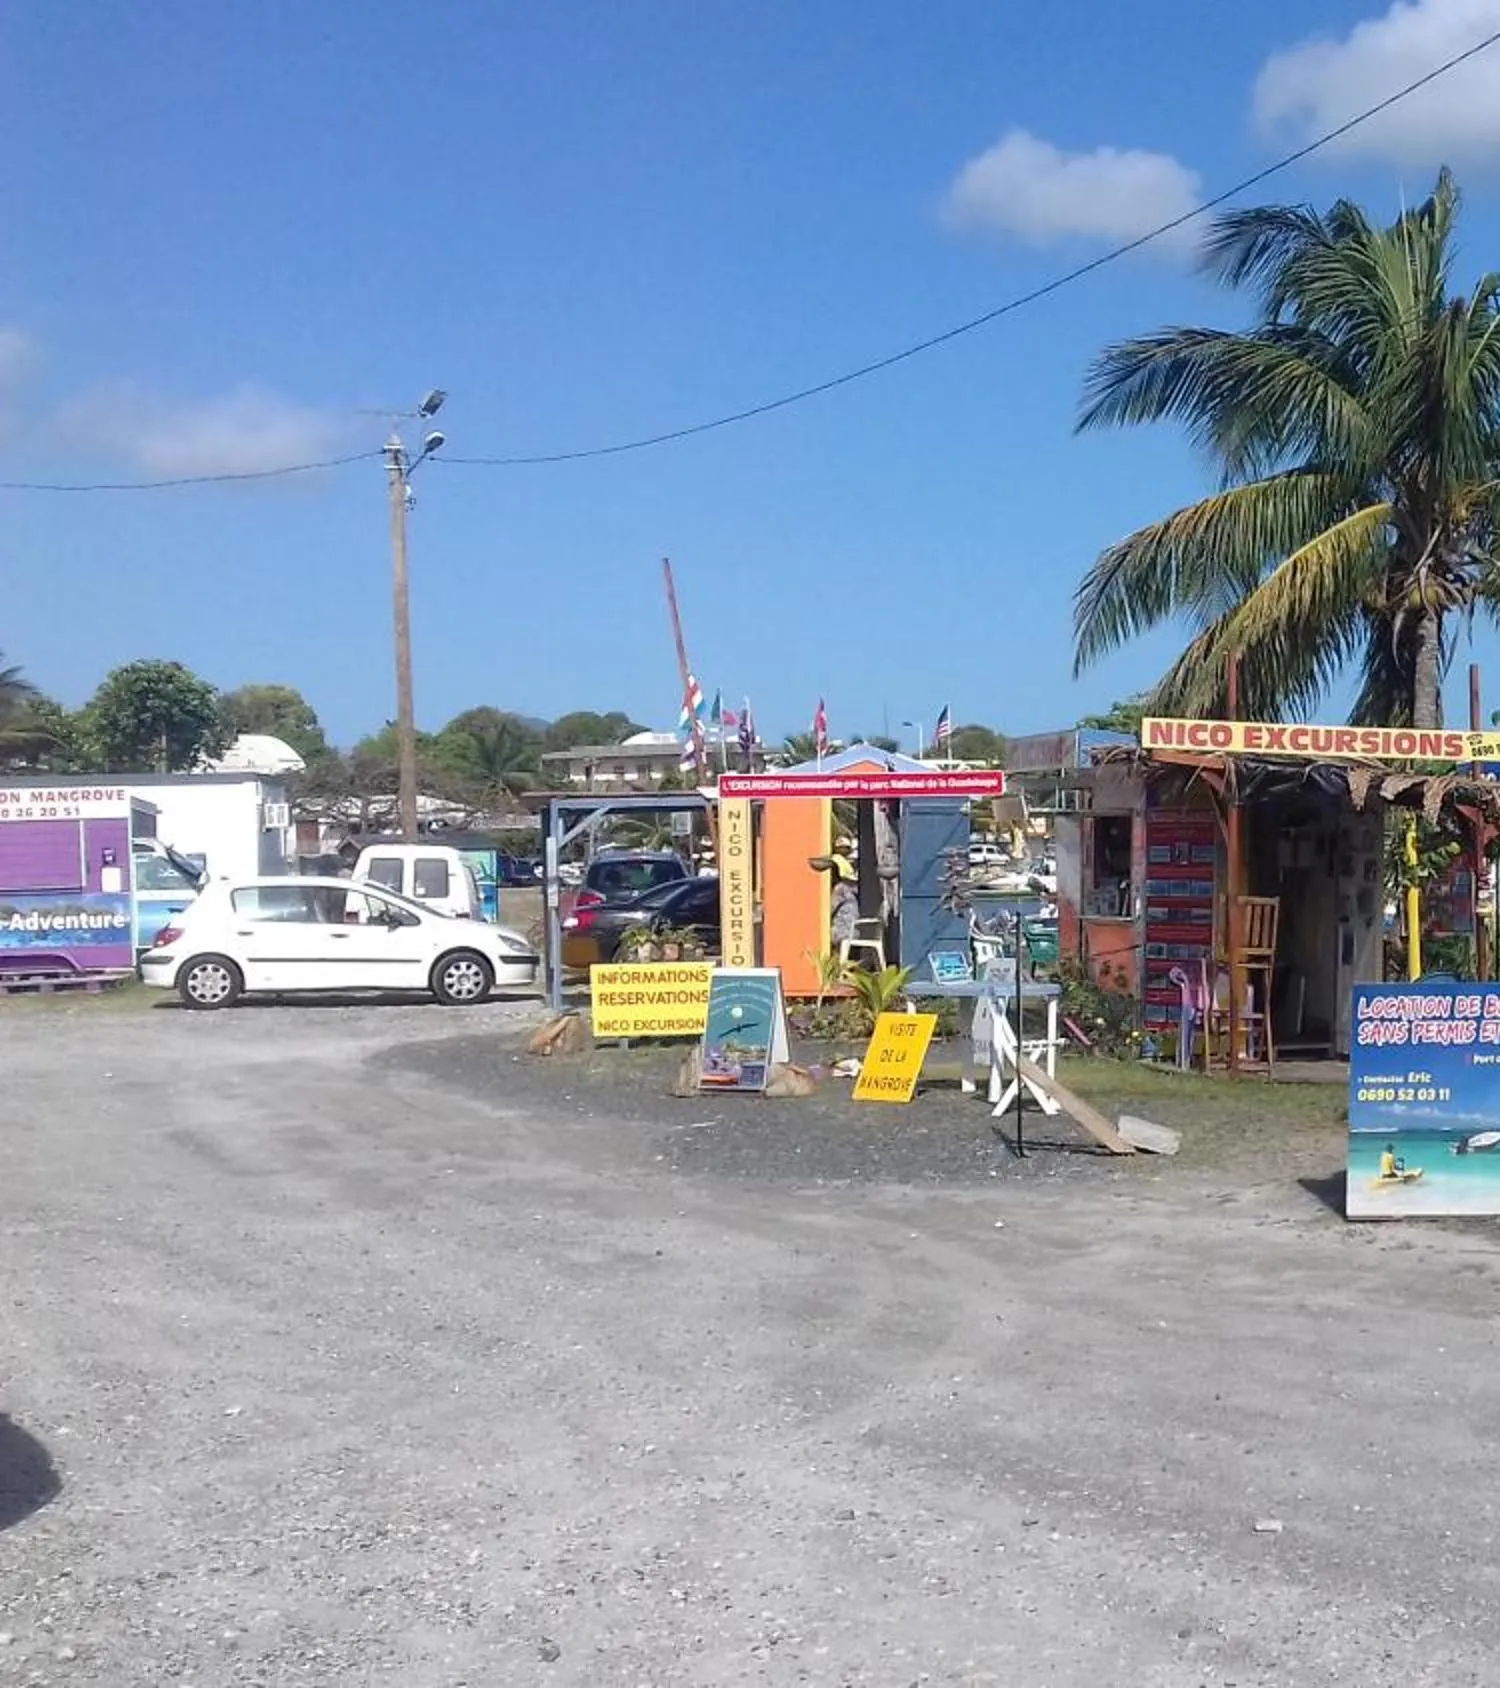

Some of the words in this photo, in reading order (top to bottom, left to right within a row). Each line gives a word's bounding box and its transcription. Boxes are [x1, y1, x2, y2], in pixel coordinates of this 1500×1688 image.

[1150, 722, 1233, 748] NICO
[1243, 726, 1464, 757] EXCURSIONS
[30, 789, 125, 803] MANGROVE
[728, 810, 742, 856] NICO
[597, 969, 708, 985] INFORMATIONS
[599, 990, 708, 1006] RESERVATIONS
[1358, 996, 1450, 1020] LOCATION
[1454, 995, 1481, 1017] DE
[598, 1019, 630, 1031] NICO
[633, 1018, 705, 1031] EXCURSION
[890, 1023, 918, 1036] VISITE
[1357, 1021, 1408, 1046] SANS
[1411, 1020, 1476, 1045] PERMIS
[1473, 1053, 1495, 1065] Port
[858, 1076, 913, 1091] MANGROVE
[1408, 1071, 1432, 1083] Eric
[1357, 1088, 1394, 1101] 0690
[1397, 1088, 1414, 1101] 52
[1416, 1088, 1435, 1101] 03
[1438, 1087, 1450, 1101] 11
